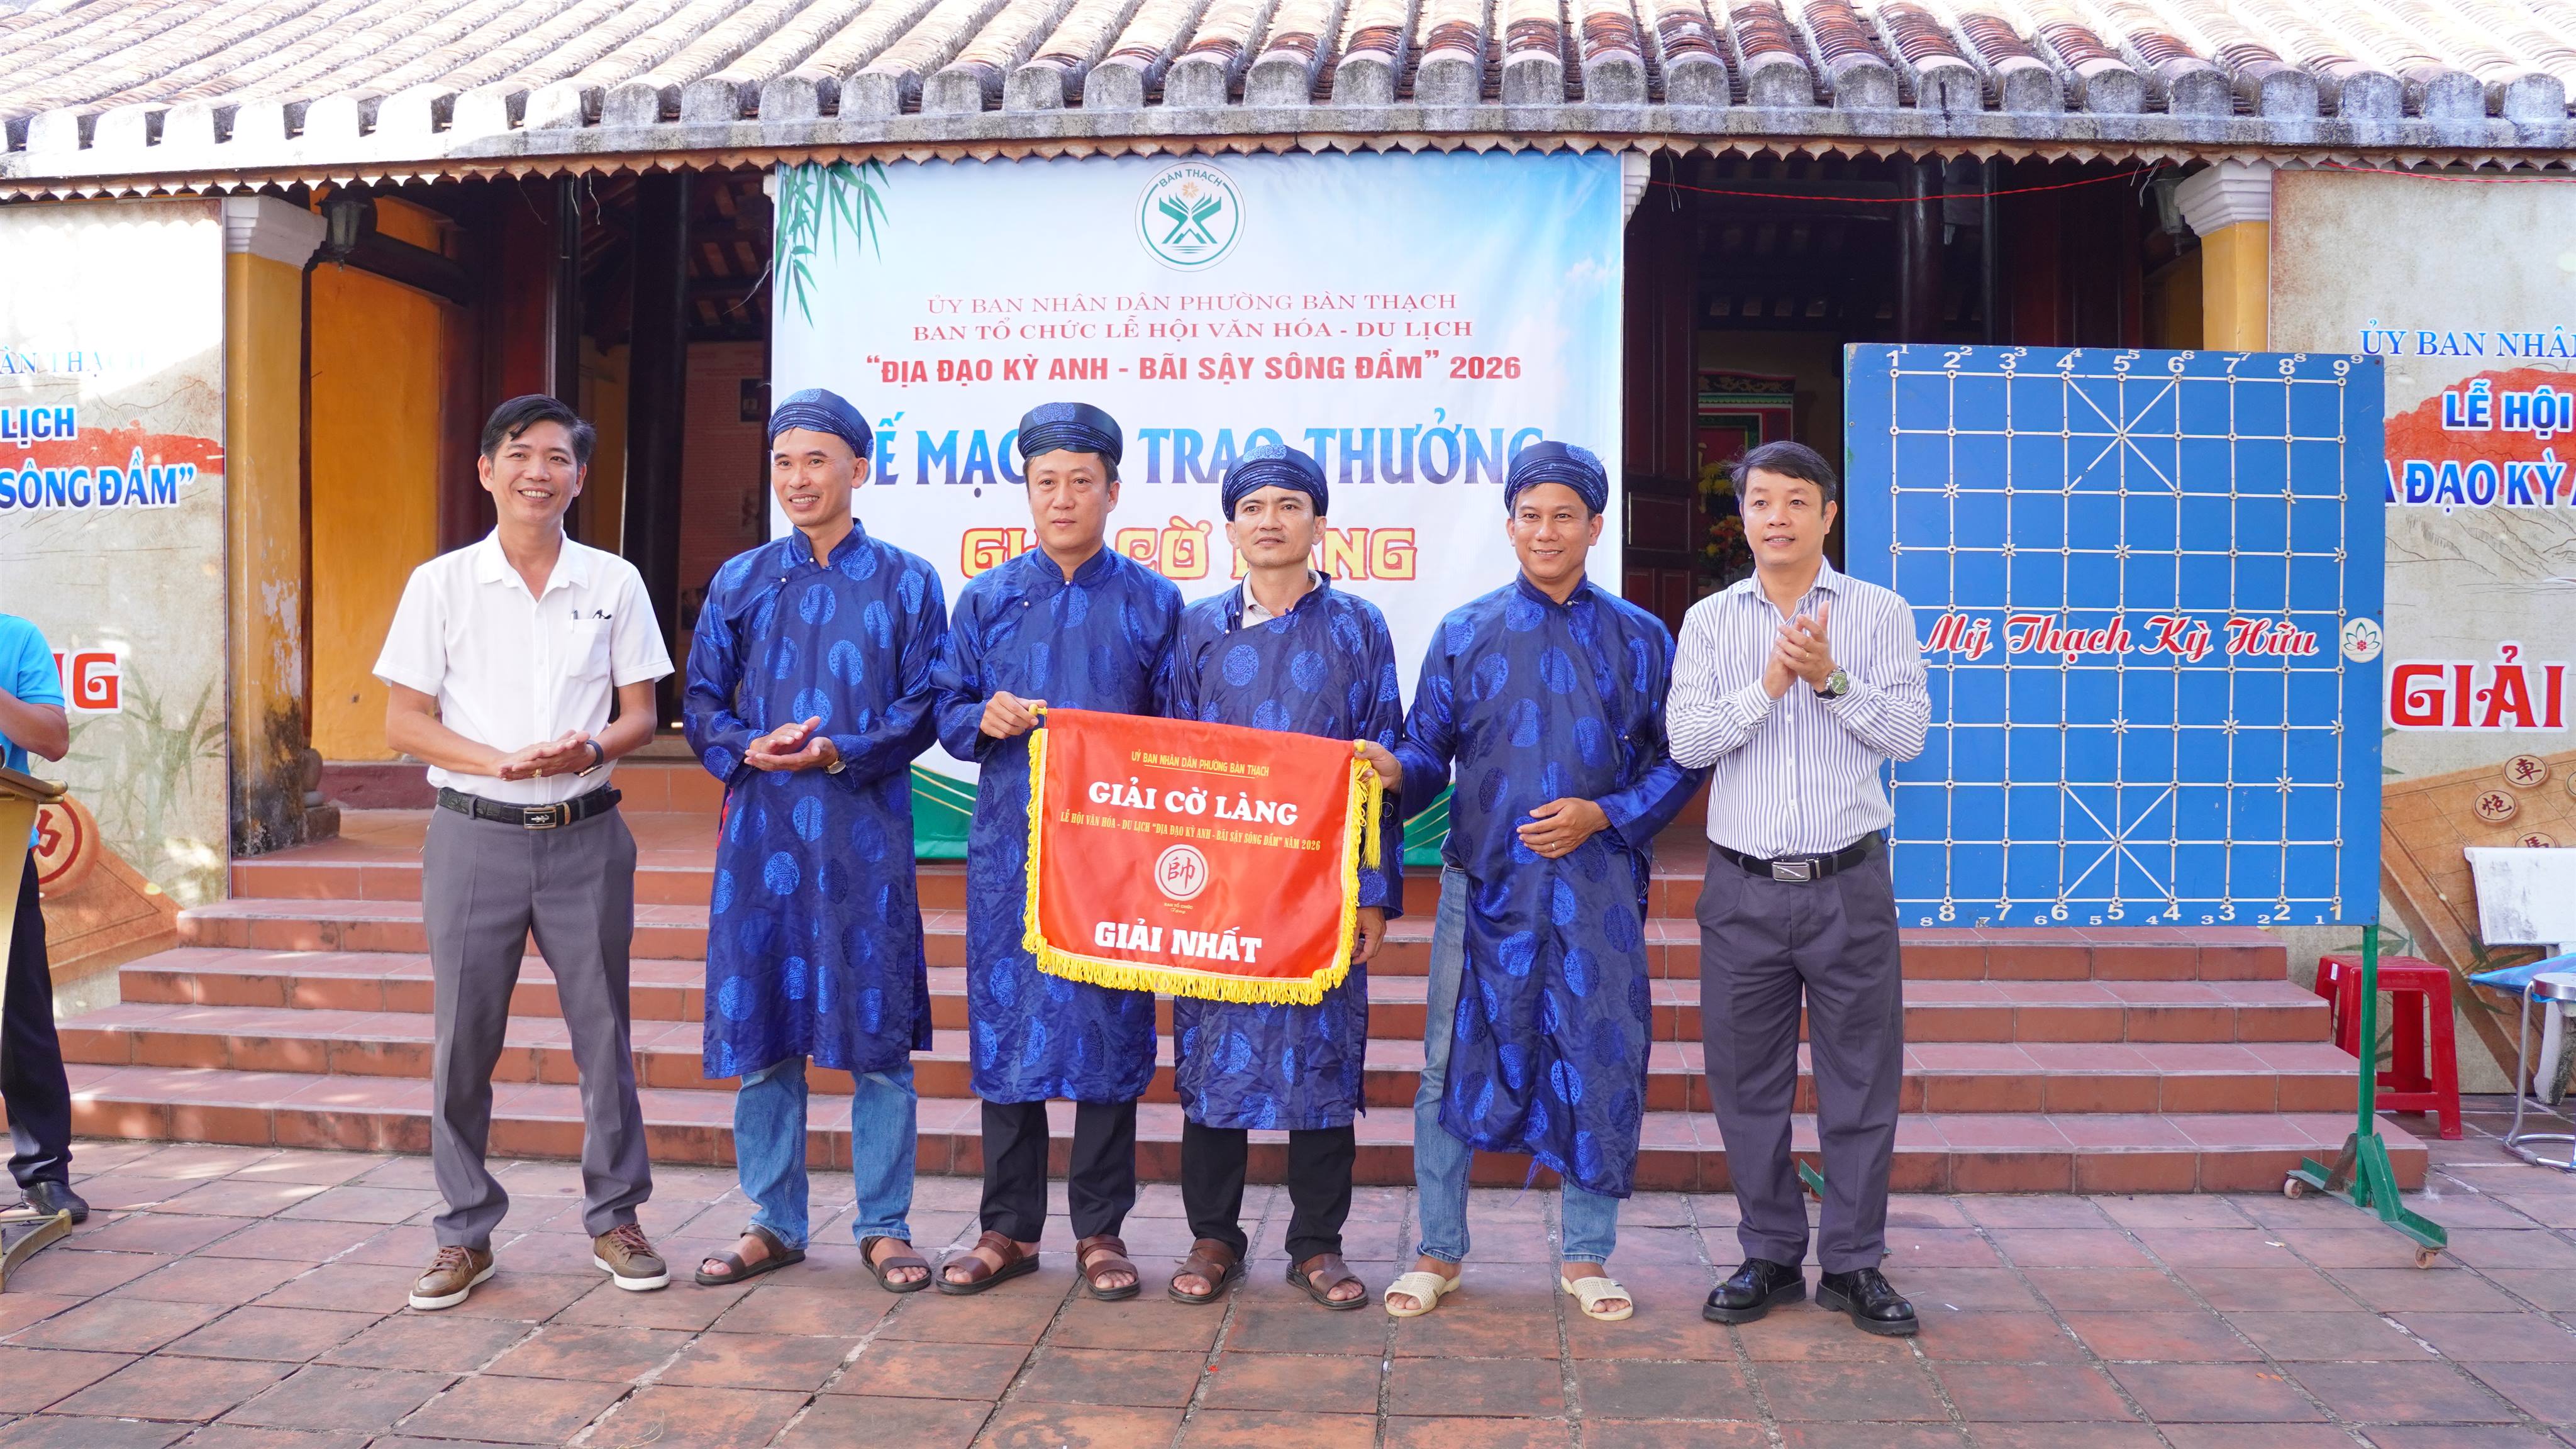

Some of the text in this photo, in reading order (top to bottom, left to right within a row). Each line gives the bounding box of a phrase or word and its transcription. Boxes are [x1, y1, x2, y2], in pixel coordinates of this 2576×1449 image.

[1158, 169, 1223, 187] BÀN THẠCH
[927, 291, 1458, 314] ỦY BAN NHÂN DÂN PHƯỜNG BÀN THẠCH
[913, 325, 968, 341] BAN
[975, 316, 1011, 340] TỔ
[1019, 319, 1096, 340] CHỨC
[1105, 314, 1140, 338] LỄ
[1148, 318, 1200, 342] HỘI
[1207, 318, 1264, 338] VĂN
[1272, 317, 1333, 338] HÓA
[1355, 321, 1396, 337] DU
[1404, 321, 1473, 341] LỊCH
[2360, 318, 2576, 358] ỦY BAN NHÂ
[867, 355, 929, 388] “ĐỊA
[936, 358, 993, 387] ĐẠO
[1003, 353, 1040, 381] KỲ
[1048, 358, 1109, 380] ANH
[1139, 352, 1187, 380] BÃI
[1197, 352, 1255, 385] SẬY
[1264, 352, 1345, 379] SÔNG
[1355, 348, 1440, 379] ĐẦM”
[1449, 356, 1521, 379] 2026
[1886, 350, 2350, 377] 1 2 3 4 5 6 7 8 9
[1960, 346, 1973, 356] 2
[2014, 347, 2028, 357] 3
[2069, 348, 2083, 357] 4
[2128, 350, 2140, 360] 5
[2182, 350, 2195, 360] 6
[2238, 352, 2251, 361] 7
[2293, 353, 2307, 362] 8
[2350, 355, 2364, 364] 9
[1, 407, 75, 445] LỊCH
[2445, 382, 2570, 436] LỄ HỘI
[0, 451, 194, 509] SÔNG ĐẦM”
[2406, 463, 2496, 513] ĐẠO
[2507, 451, 2564, 506] KỲ
[1115, 515, 1213, 580] CỜ
[1919, 614, 2319, 663] Mỹ Thạch Kỳ Hữu
[2390, 645, 2565, 728] GIẢI
[1143, 752, 1158, 764] BAN
[1159, 753, 1180, 767] NHÂN
[1181, 755, 1197, 769] DÂN
[1199, 758, 1228, 772] PHƯỜNG
[1230, 761, 1245, 774] BÀN
[1247, 765, 1270, 778] THẠCH
[2515, 758, 2542, 781] 車
[1088, 776, 1299, 826] GIẢI CỜ LÀNG
[1060, 809, 1070, 823] LỄ
[1070, 811, 1084, 826] HỘI
[1085, 814, 1101, 826] VĂN
[1101, 815, 1116, 828] HÓA
[1122, 819, 1133, 831] DU
[1133, 820, 1150, 833] LỊCH
[1170, 824, 1184, 838] ĐẠO
[1185, 825, 1196, 838] KỲ
[1196, 828, 1212, 840] ANH
[1216, 828, 1228, 841] BÃI
[1230, 830, 1243, 845] SẬY
[1244, 831, 1262, 845] SÔNG
[1284, 837, 1300, 850] NĂM
[1301, 840, 1321, 851] 2026
[1167, 856, 1196, 890] 帥
[1919, 916, 1934, 926] 8
[2034, 915, 2048, 925] 6
[2089, 915, 2102, 925] 5
[2145, 915, 2159, 925] 4
[2201, 915, 2214, 924] 3
[2257, 914, 2270, 924] 2
[2314, 915, 2325, 924] 1
[1938, 904, 2342, 921] 8 7 6 5 4 3 2 1
[1094, 918, 1262, 963] GIẢI NHẤT
